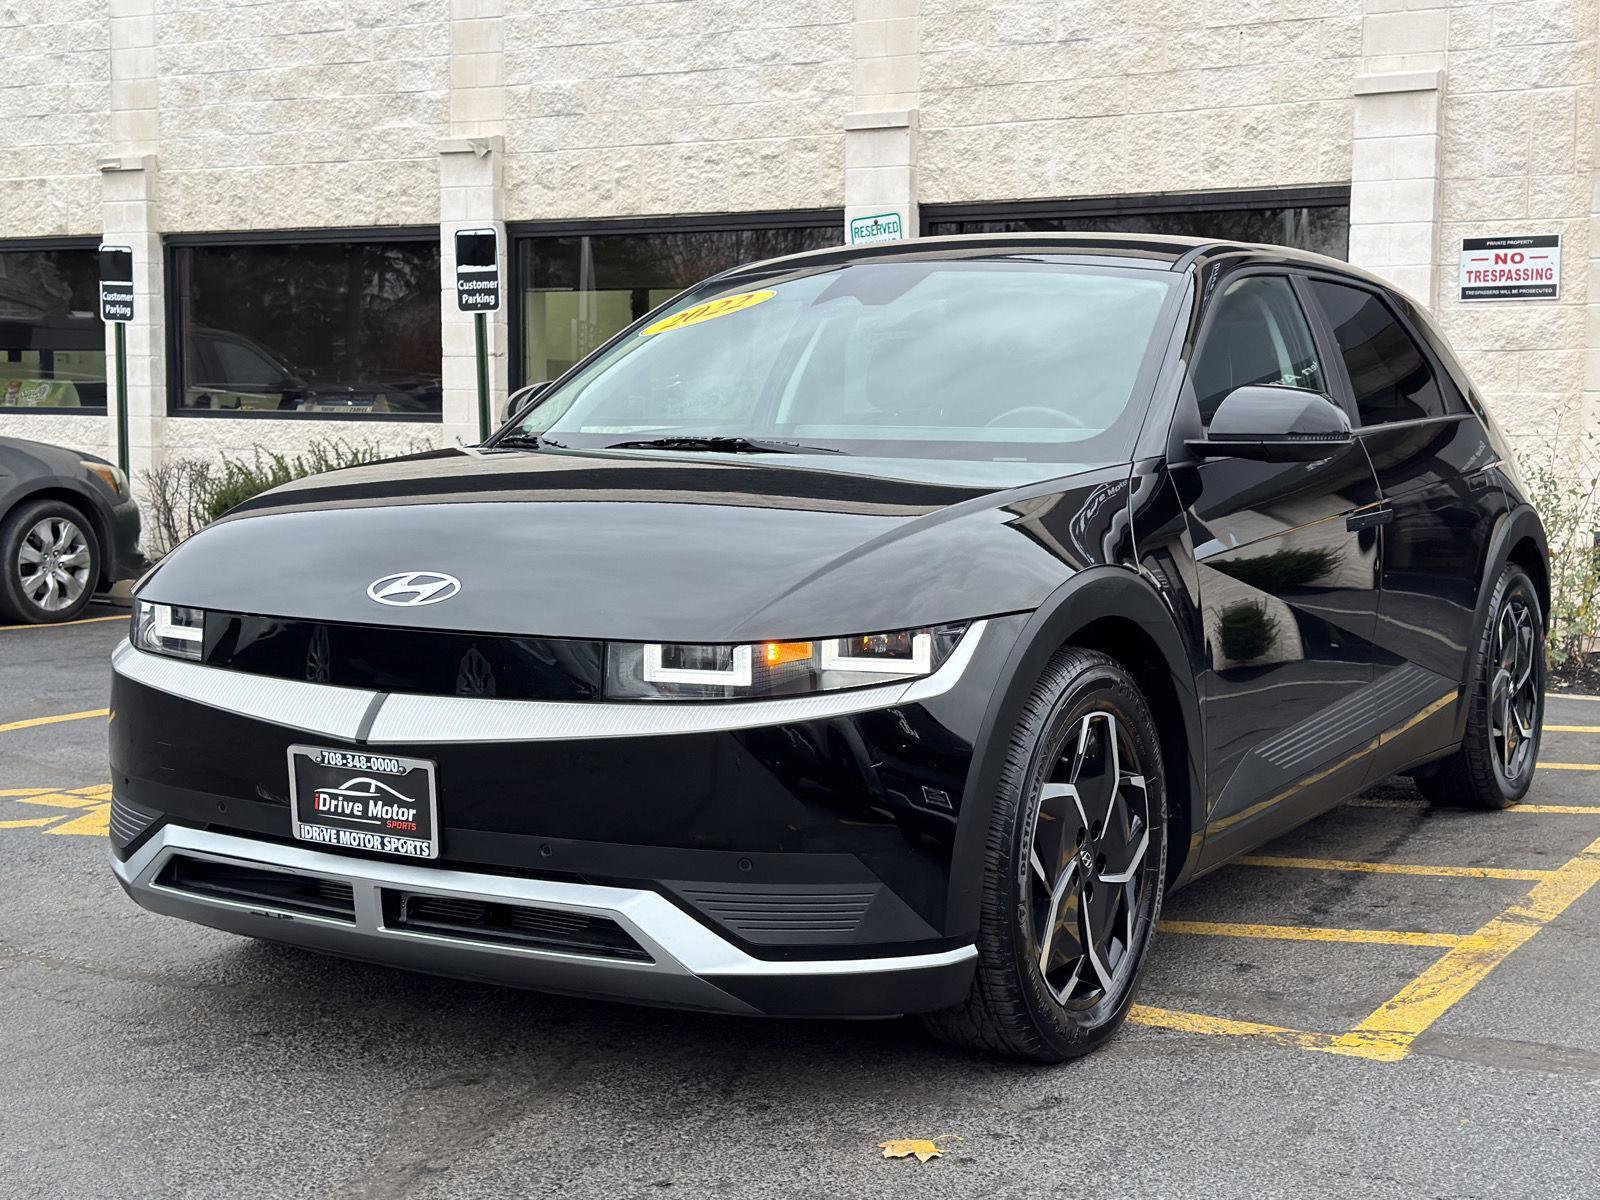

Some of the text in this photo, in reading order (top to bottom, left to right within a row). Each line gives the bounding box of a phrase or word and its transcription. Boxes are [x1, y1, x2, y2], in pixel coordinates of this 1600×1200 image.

[854, 221, 899, 238] RESERVED
[1494, 252, 1525, 265] NO
[1466, 267, 1554, 283] TRESPASSING
[458, 280, 498, 290] Customer
[103, 292, 133, 301] Customer
[462, 293, 496, 305] Parking
[105, 304, 131, 317] Parking
[659, 294, 755, 331] 2022
[322, 751, 399, 773] 708-348-0000
[314, 793, 416, 822] iDrive Motor
[386, 820, 417, 831] SPORTS
[340, 830, 382, 849] MOTOR
[384, 838, 430, 856] SPORTS
